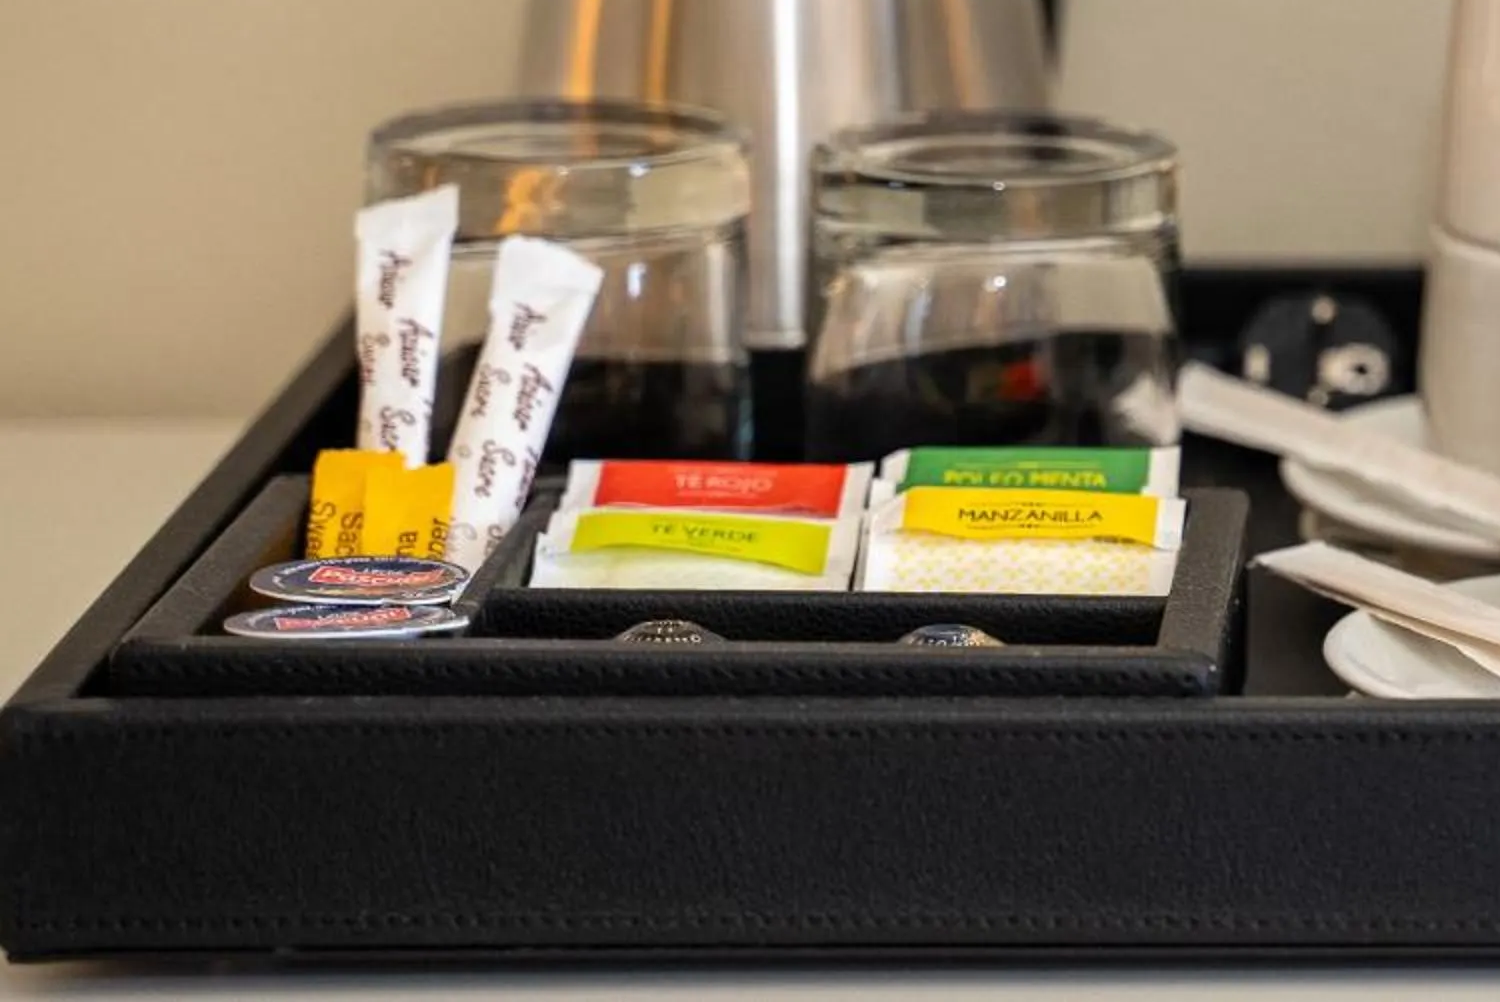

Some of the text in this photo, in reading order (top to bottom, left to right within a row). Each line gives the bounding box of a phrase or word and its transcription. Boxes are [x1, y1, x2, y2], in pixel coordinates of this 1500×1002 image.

[474, 439, 516, 498] Sucre
[706, 475, 774, 494] ROJO
[1029, 470, 1108, 488] MENTA
[957, 507, 1104, 523] MANZANILLA
[683, 524, 757, 543] VERDE
